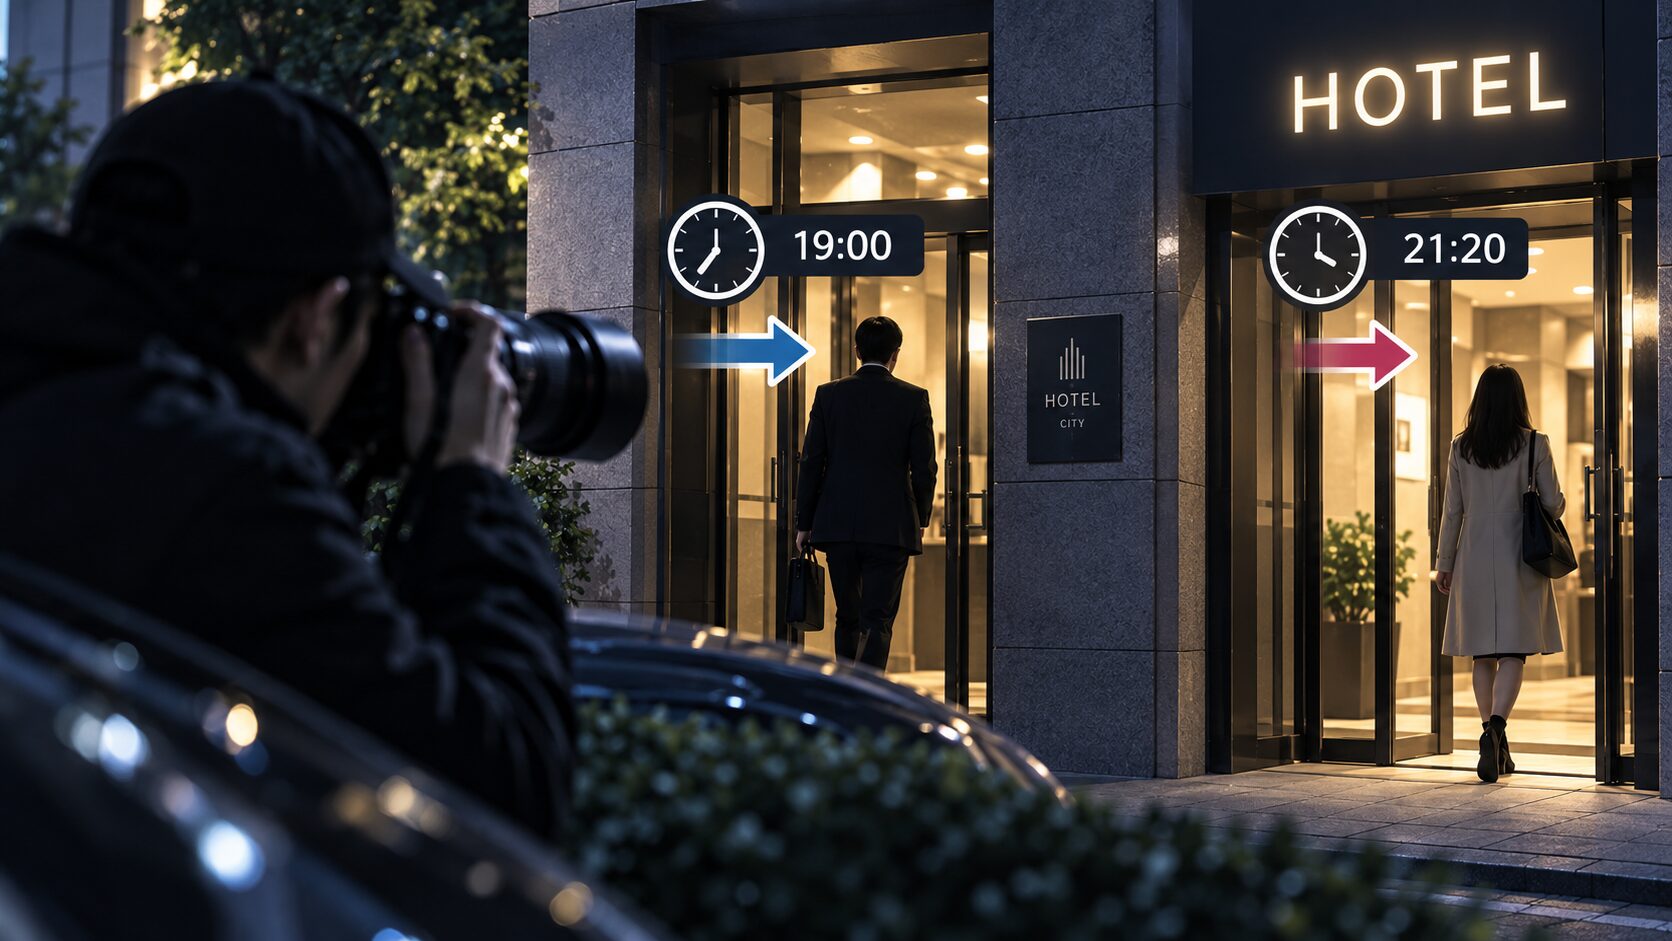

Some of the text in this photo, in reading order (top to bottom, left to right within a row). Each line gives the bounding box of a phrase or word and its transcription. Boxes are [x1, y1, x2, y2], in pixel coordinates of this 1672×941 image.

[1294, 51, 1567, 133] HOTEL
[1045, 391, 1101, 408] HOTEL
[1060, 418, 1085, 429] CITY
